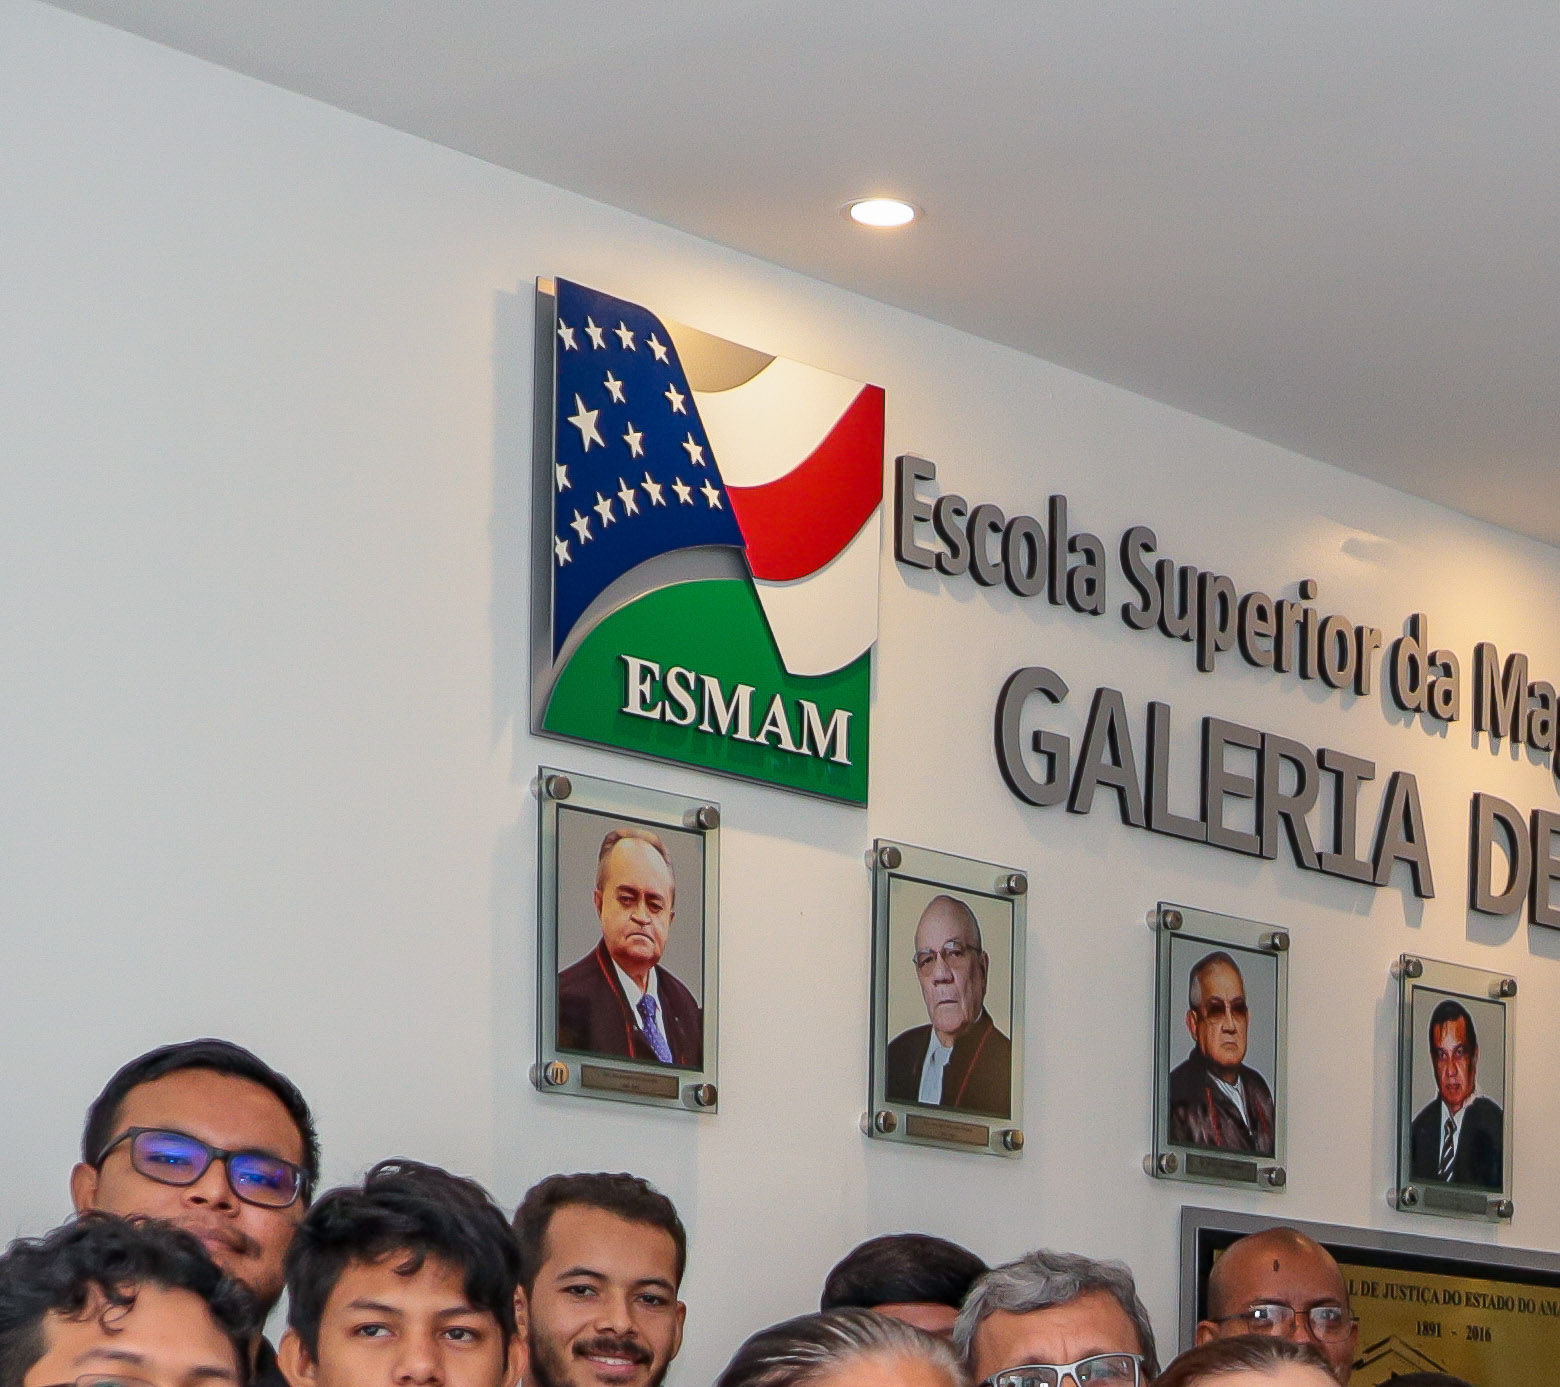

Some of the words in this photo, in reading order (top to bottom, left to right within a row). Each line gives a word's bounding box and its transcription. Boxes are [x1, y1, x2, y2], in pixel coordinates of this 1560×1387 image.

[895, 455, 1107, 616] Escola
[1120, 525, 1383, 697] Superior
[1389, 612, 1461, 723] da
[619, 653, 853, 767] ESMAM
[995, 665, 1435, 900] GALERIA
[1360, 1281, 1378, 1298] DE
[1382, 1283, 1440, 1306] JUSTIÇA
[1442, 1288, 1462, 1306] DO
[1464, 1291, 1515, 1312] ESTADO
[1517, 1298, 1536, 1314] DO
[1416, 1321, 1441, 1338] 1891
[1466, 1325, 1492, 1342] 2016
